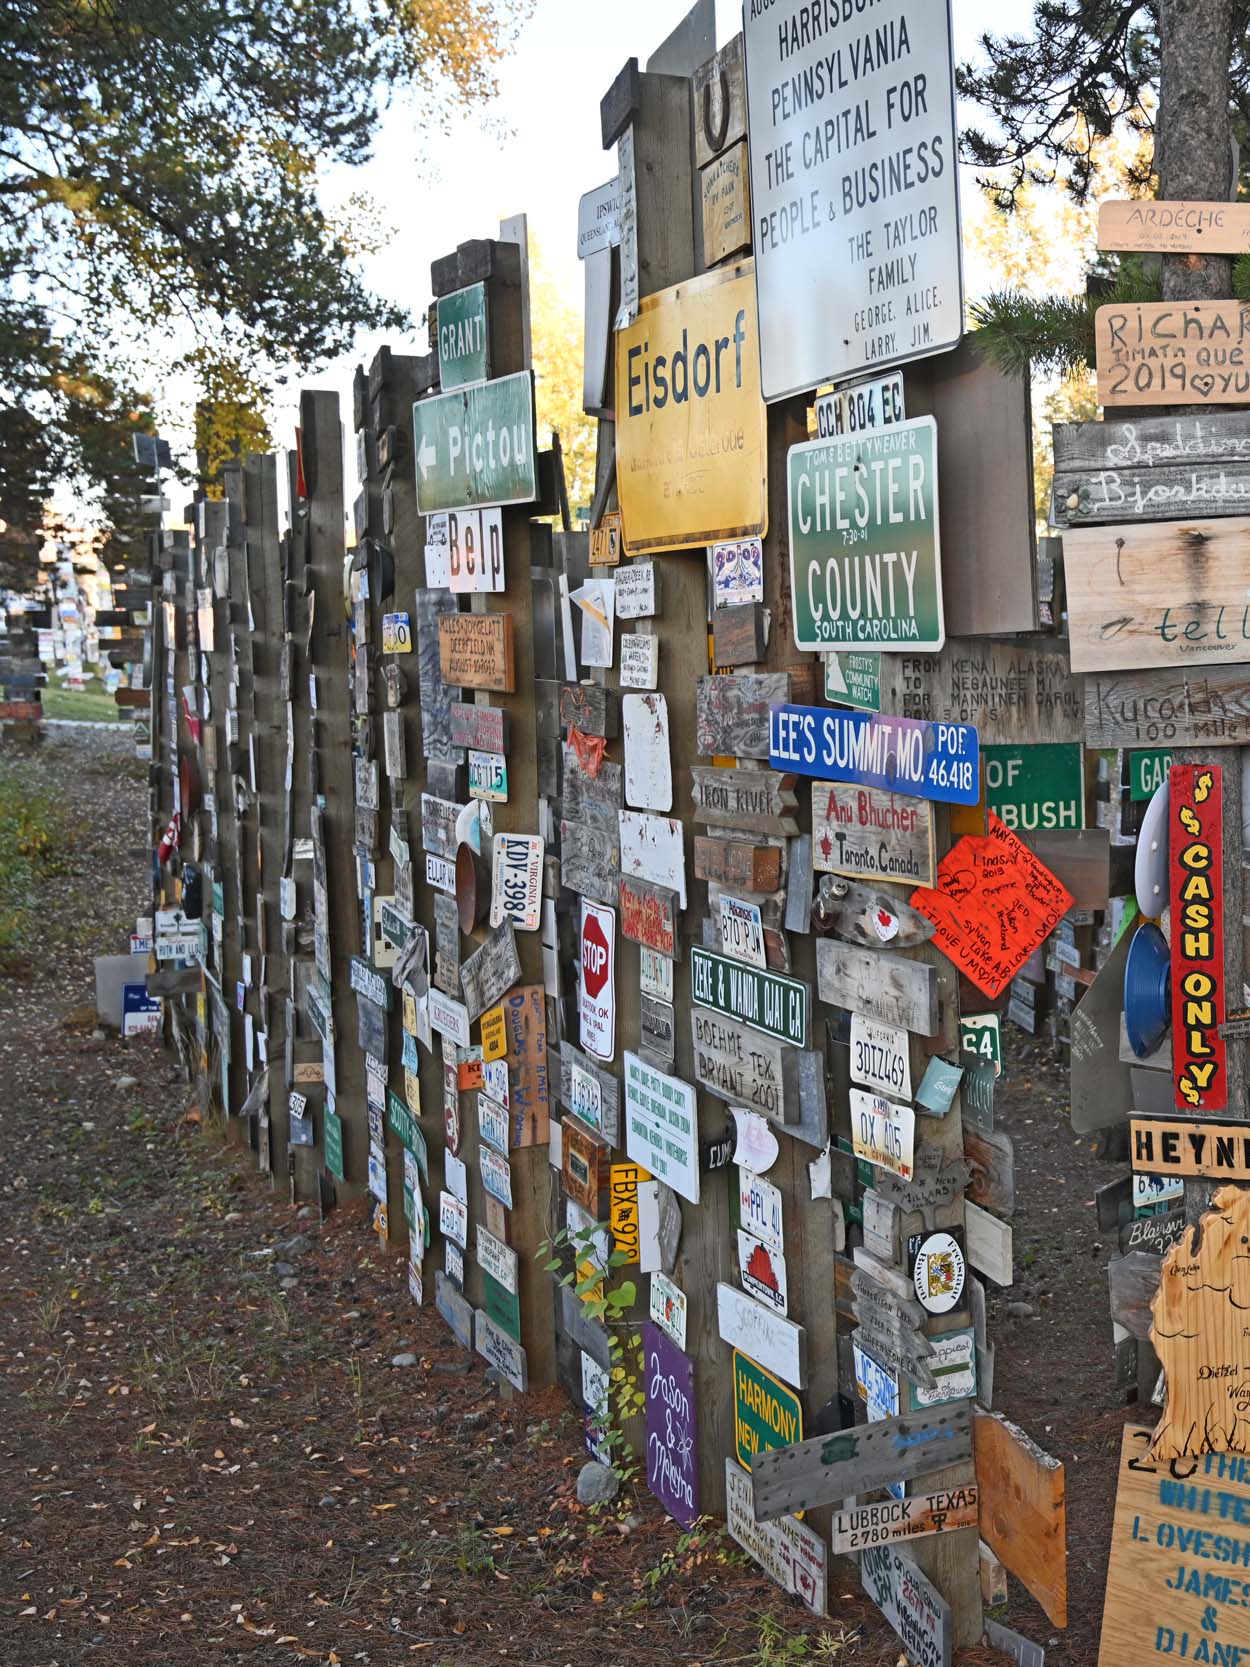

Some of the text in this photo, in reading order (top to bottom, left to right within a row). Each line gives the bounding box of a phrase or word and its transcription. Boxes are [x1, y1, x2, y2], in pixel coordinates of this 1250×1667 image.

[771, 16, 911, 127] PENNSYLVANIA
[765, 141, 795, 190] THE
[802, 100, 877, 170] CAPITAL
[887, 73, 928, 129] FOR
[760, 135, 945, 255] PEOPLE & BUSINESS
[848, 206, 939, 265] THE TAYLOR
[868, 252, 918, 296] FAMILY
[441, 316, 482, 361] GRANT
[628, 309, 746, 417] Eisdorf
[1107, 361, 1188, 396] 2019
[449, 423, 527, 477] Pictou
[805, 451, 828, 470] TOM
[797, 454, 927, 534] CHESTER
[808, 550, 919, 622] COUNTY
[814, 618, 919, 641] SOUTH CAROLINA
[1179, 641, 1238, 653] Vancouver
[903, 659, 942, 674] FROM
[904, 677, 921, 690] TO
[852, 687, 873, 703] WATCH
[904, 693, 930, 706] FOR
[960, 709, 979, 721] OF
[769, 710, 816, 763] LEE'S
[823, 717, 893, 775] SUMMIT
[1135, 722, 1178, 742] 100
[985, 758, 1023, 788] OF
[701, 786, 774, 815] IRON RIVER
[878, 841, 920, 877] Canada
[527, 860, 540, 907] VIRGINIA
[1181, 842, 1214, 960] CASH
[583, 936, 608, 976] STOP
[694, 956, 802, 1039] ZEKE WANDA OJAI CA
[695, 1015, 744, 1061] BOEHME
[1183, 972, 1219, 1090] ONLY
[699, 1052, 744, 1098] BRYANT
[738, 1369, 798, 1444] HARMONY
[737, 1418, 760, 1455] NEW
[838, 1487, 978, 1534] LUBBOCK TEXAS
[850, 1521, 926, 1547] 2780 miles
[1200, 1605, 1219, 1633] &
